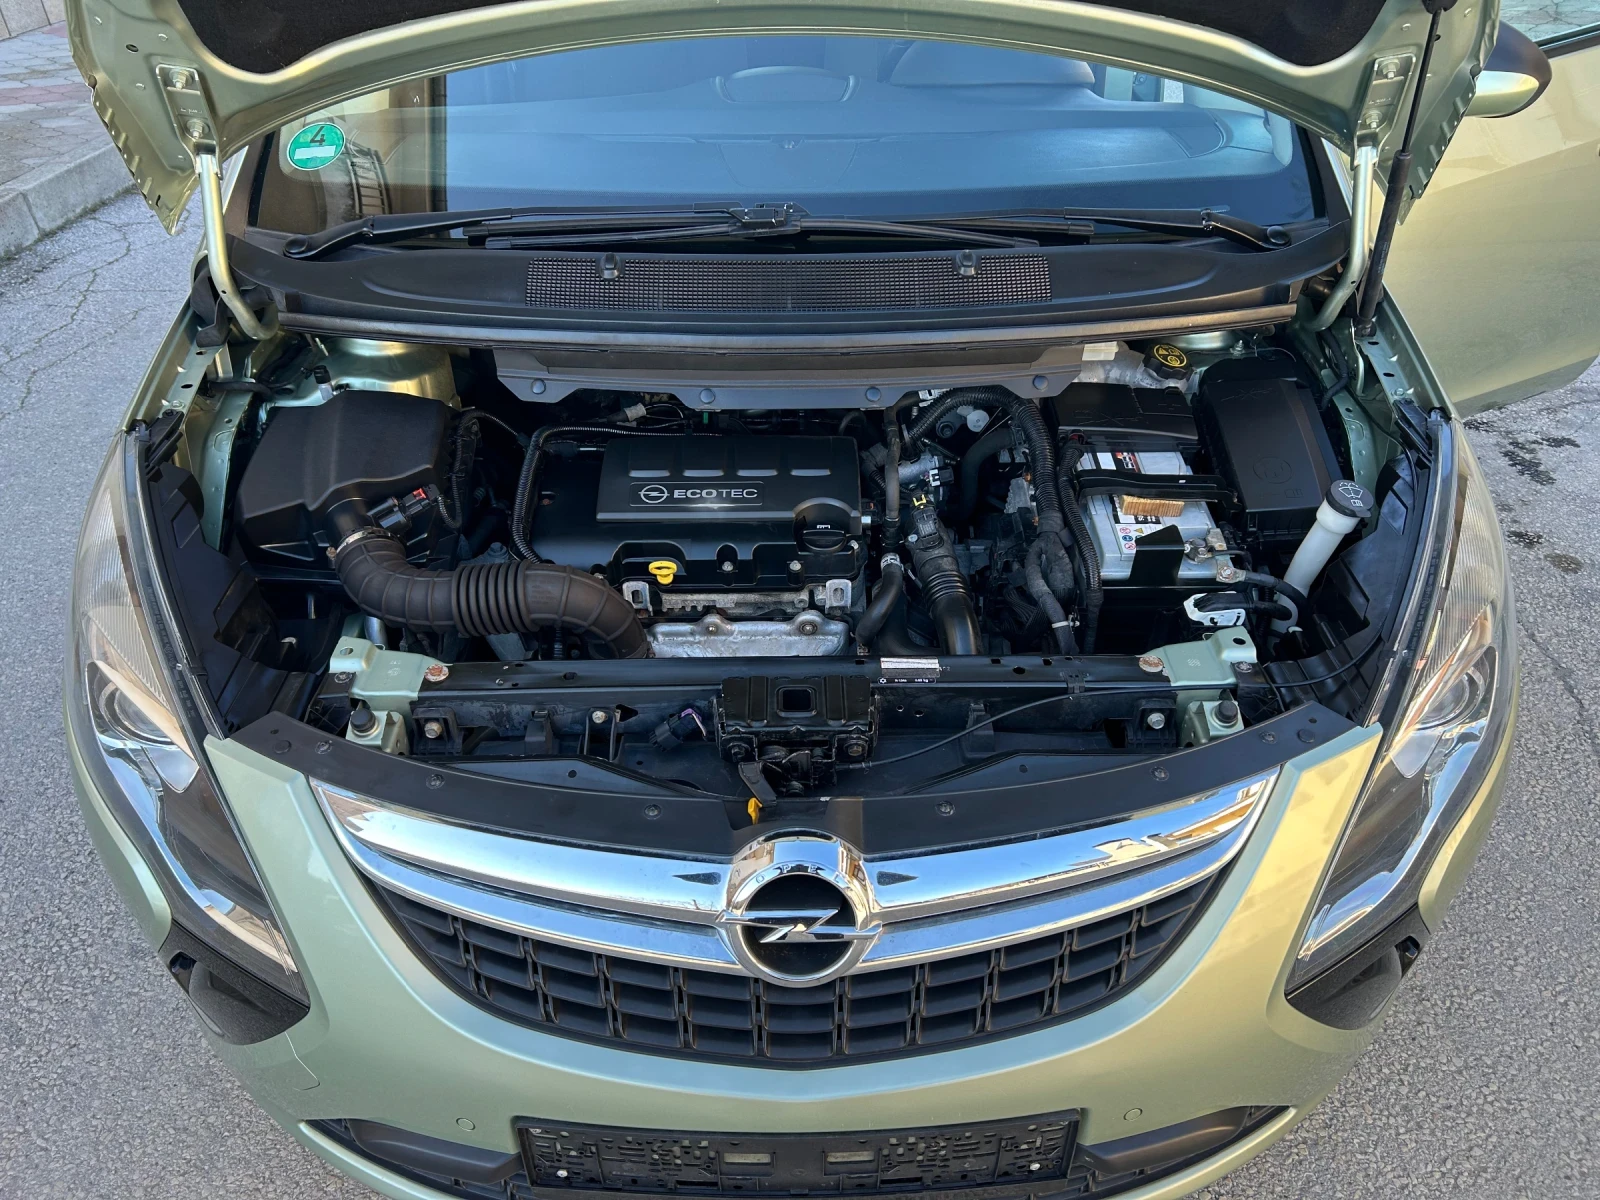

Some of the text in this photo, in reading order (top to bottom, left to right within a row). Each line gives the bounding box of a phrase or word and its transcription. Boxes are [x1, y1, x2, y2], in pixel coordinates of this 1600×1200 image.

[309, 125, 326, 146] 4
[673, 488, 758, 499] ECOTEC
[755, 863, 840, 884] OPEL
